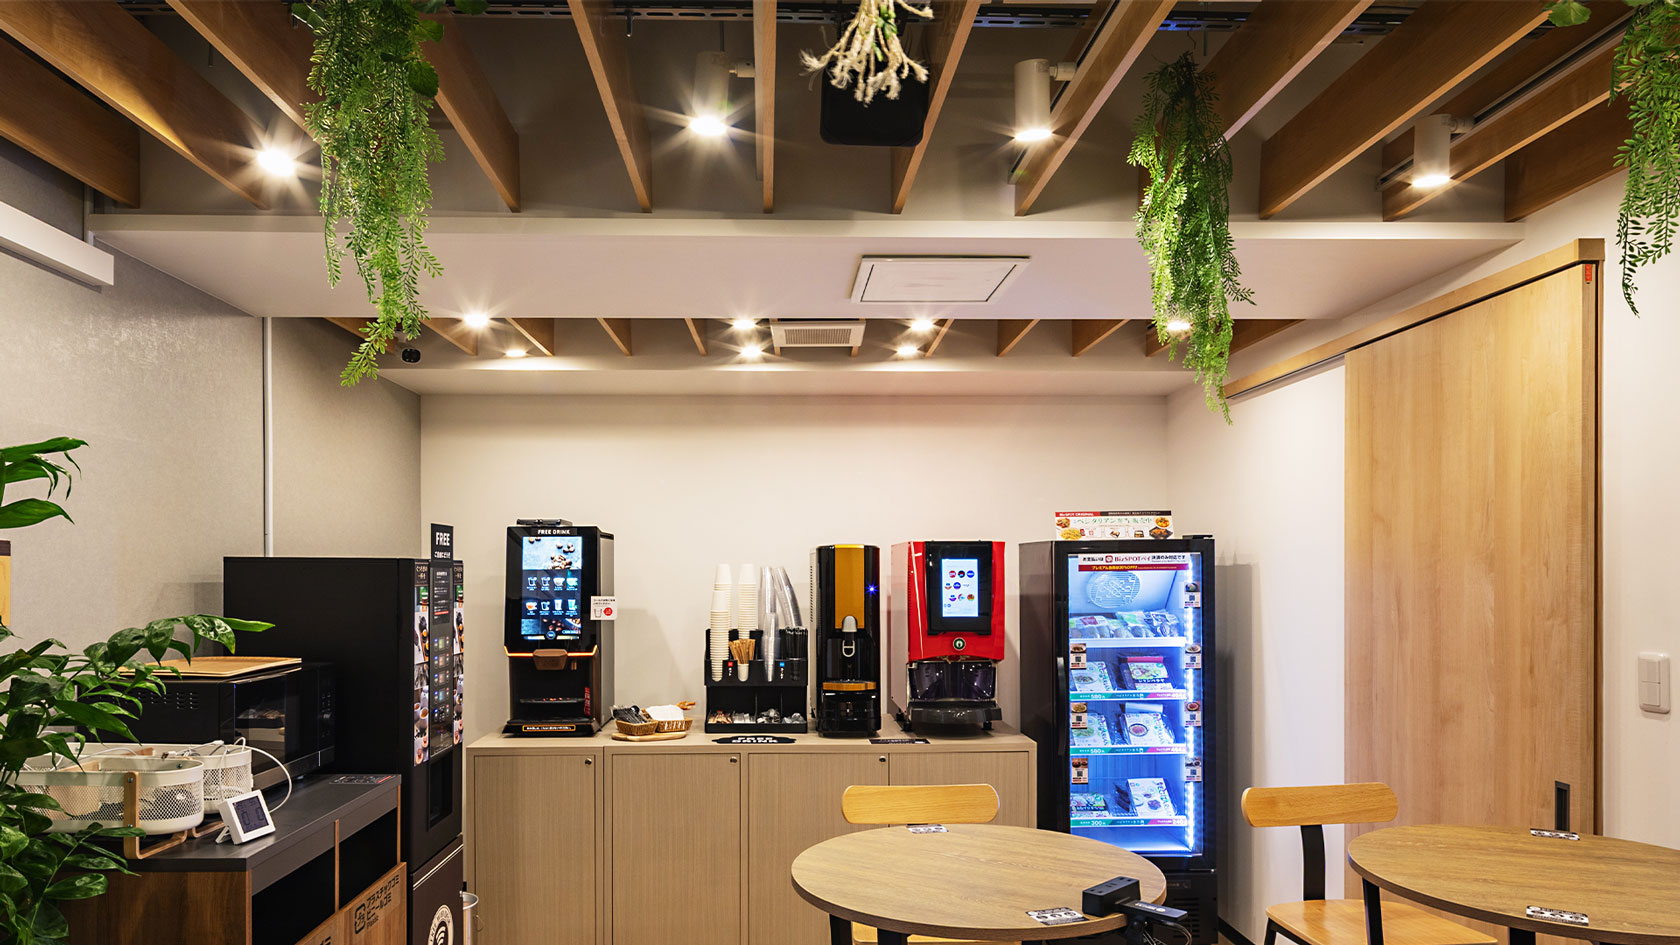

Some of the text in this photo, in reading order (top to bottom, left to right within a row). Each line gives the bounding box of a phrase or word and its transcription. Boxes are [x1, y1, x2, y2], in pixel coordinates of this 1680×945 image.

[435, 532, 451, 547] FREE
[367, 874, 400, 908] プラスチックゴミ
[367, 892, 392, 920] ビニールゴミ
